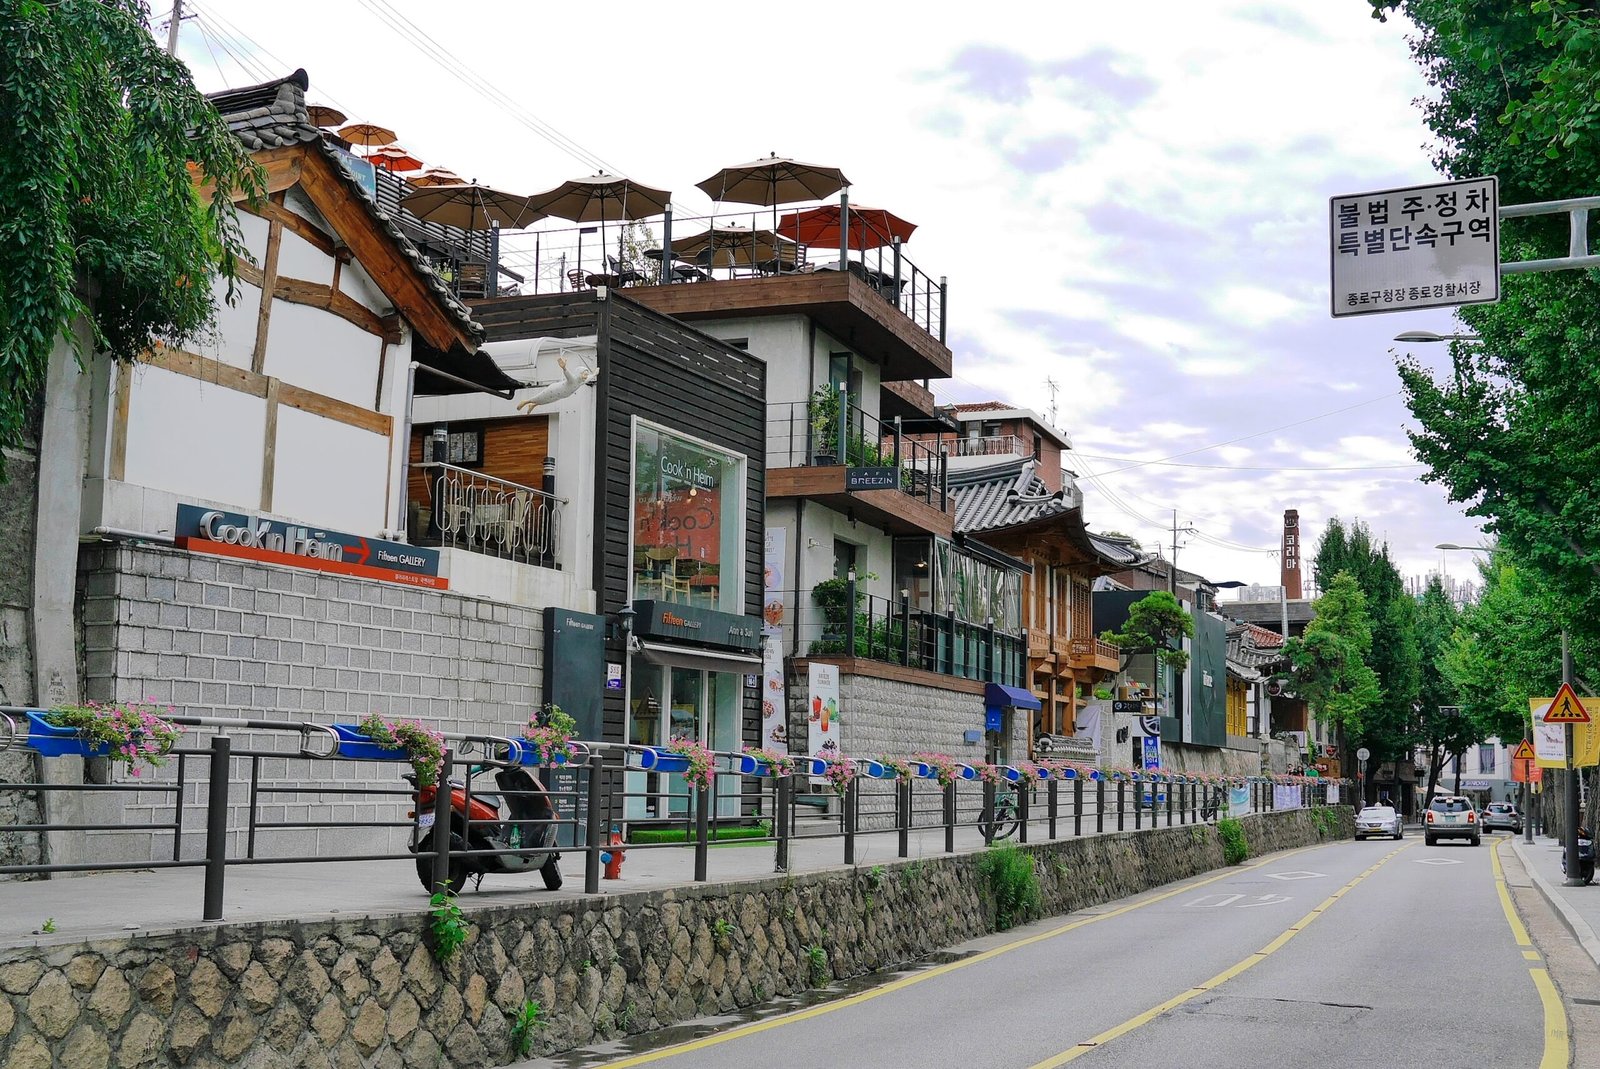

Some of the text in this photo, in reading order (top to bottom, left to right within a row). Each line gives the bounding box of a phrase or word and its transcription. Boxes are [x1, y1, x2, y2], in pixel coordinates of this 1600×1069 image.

[1338, 199, 1389, 230] 불법
[1347, 280, 1482, 307] 종로구청장 종로경찰서장
[693, 466, 714, 488] Heim
[851, 477, 893, 485] BREEZIN
[284, 525, 343, 563] Heim
[377, 550, 427, 568] Fifteen GALLERY
[662, 612, 684, 626] Fifteen
